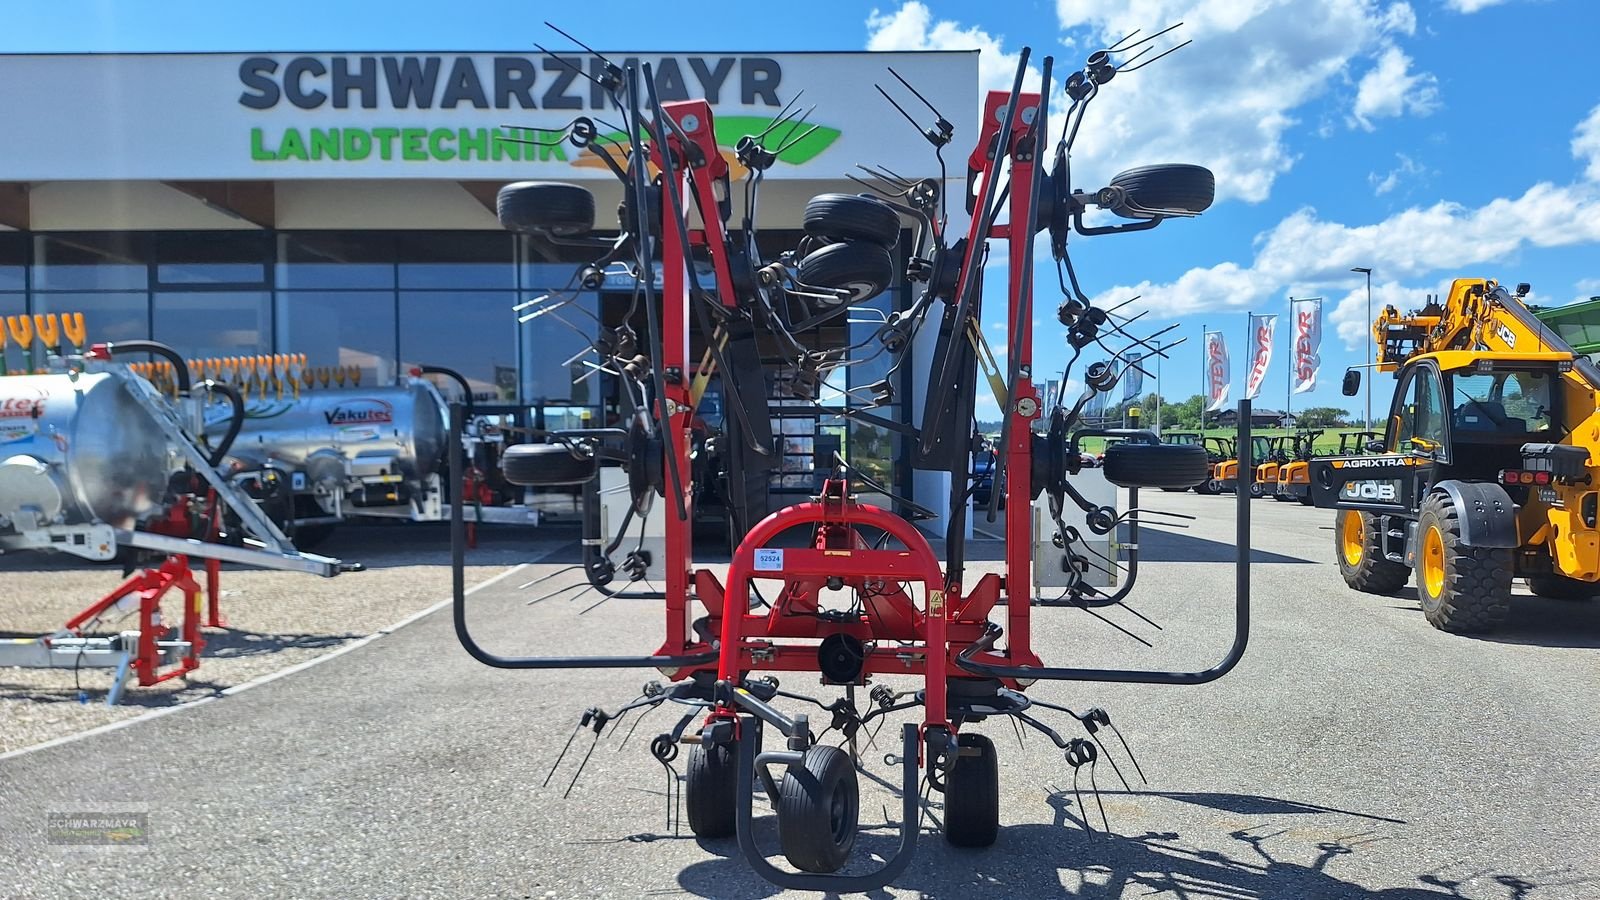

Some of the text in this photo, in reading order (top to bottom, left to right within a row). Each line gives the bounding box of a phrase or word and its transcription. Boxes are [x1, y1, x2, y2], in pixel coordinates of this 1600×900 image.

[238, 57, 781, 110] SCHWARZMAYR
[251, 128, 567, 161] LANDTECHNIK
[1297, 311, 1313, 381] STEYR
[1497, 324, 1516, 349] JCB
[1209, 341, 1223, 400] STEYR
[1250, 326, 1268, 389] STEYR
[324, 407, 392, 424] Vakutec
[1343, 459, 1405, 468] AGRIXTRA
[1346, 483, 1395, 499] JCB
